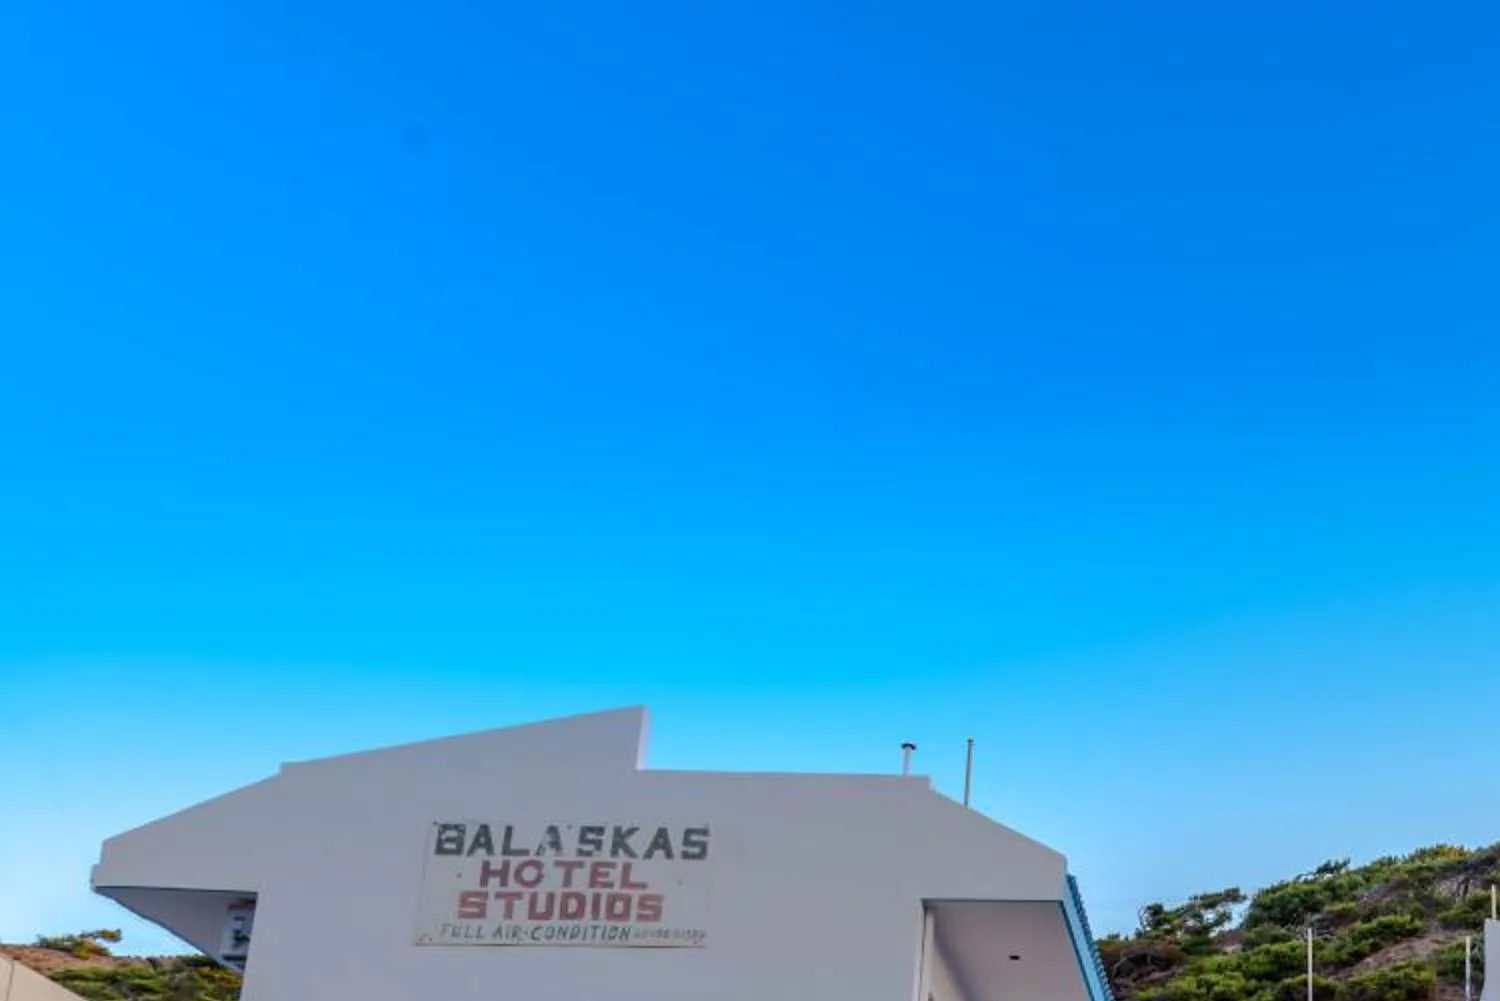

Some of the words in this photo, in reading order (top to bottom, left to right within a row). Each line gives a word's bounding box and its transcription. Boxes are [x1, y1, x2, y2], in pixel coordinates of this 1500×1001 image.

[434, 823, 710, 860] BALASKAS
[480, 859, 648, 889] HOTEL
[457, 891, 664, 922] STUDIOS
